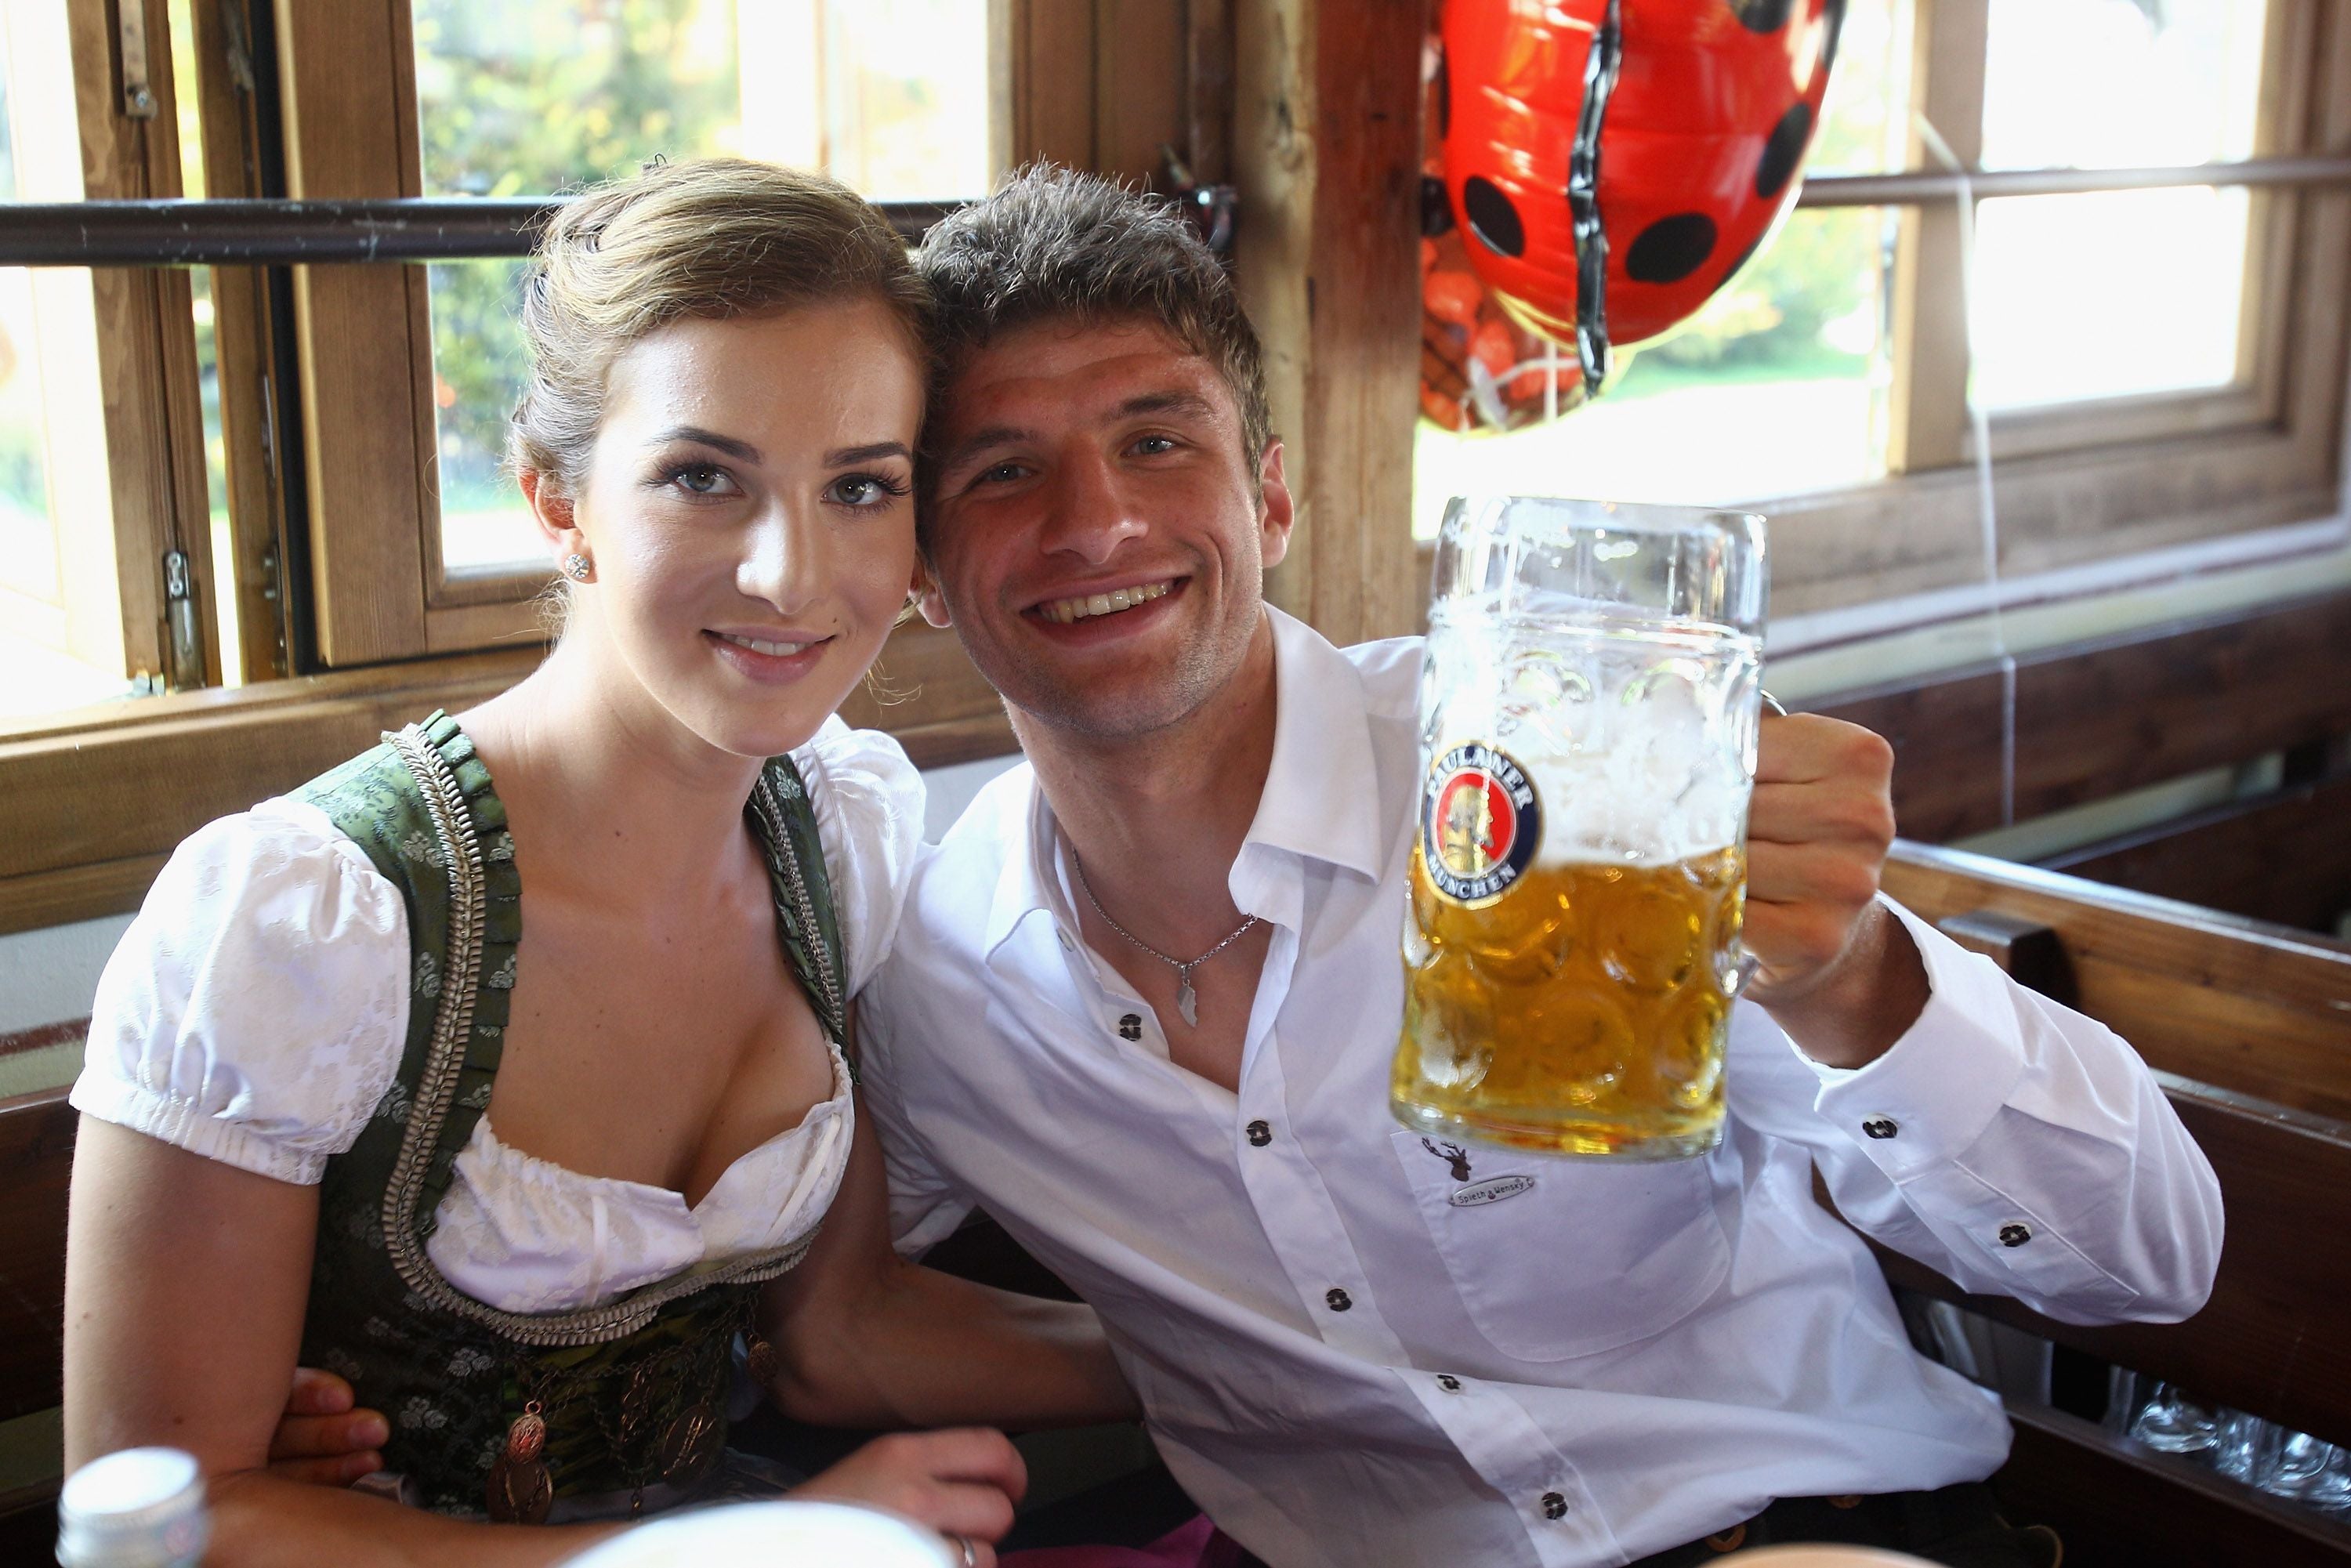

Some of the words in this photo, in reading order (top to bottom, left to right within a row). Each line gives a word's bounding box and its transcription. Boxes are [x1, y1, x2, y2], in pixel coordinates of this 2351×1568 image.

[1426, 745, 1534, 810] PAULANER
[1458, 1191, 1487, 1204] Spieth
[1494, 1182, 1524, 1194] Wensky
